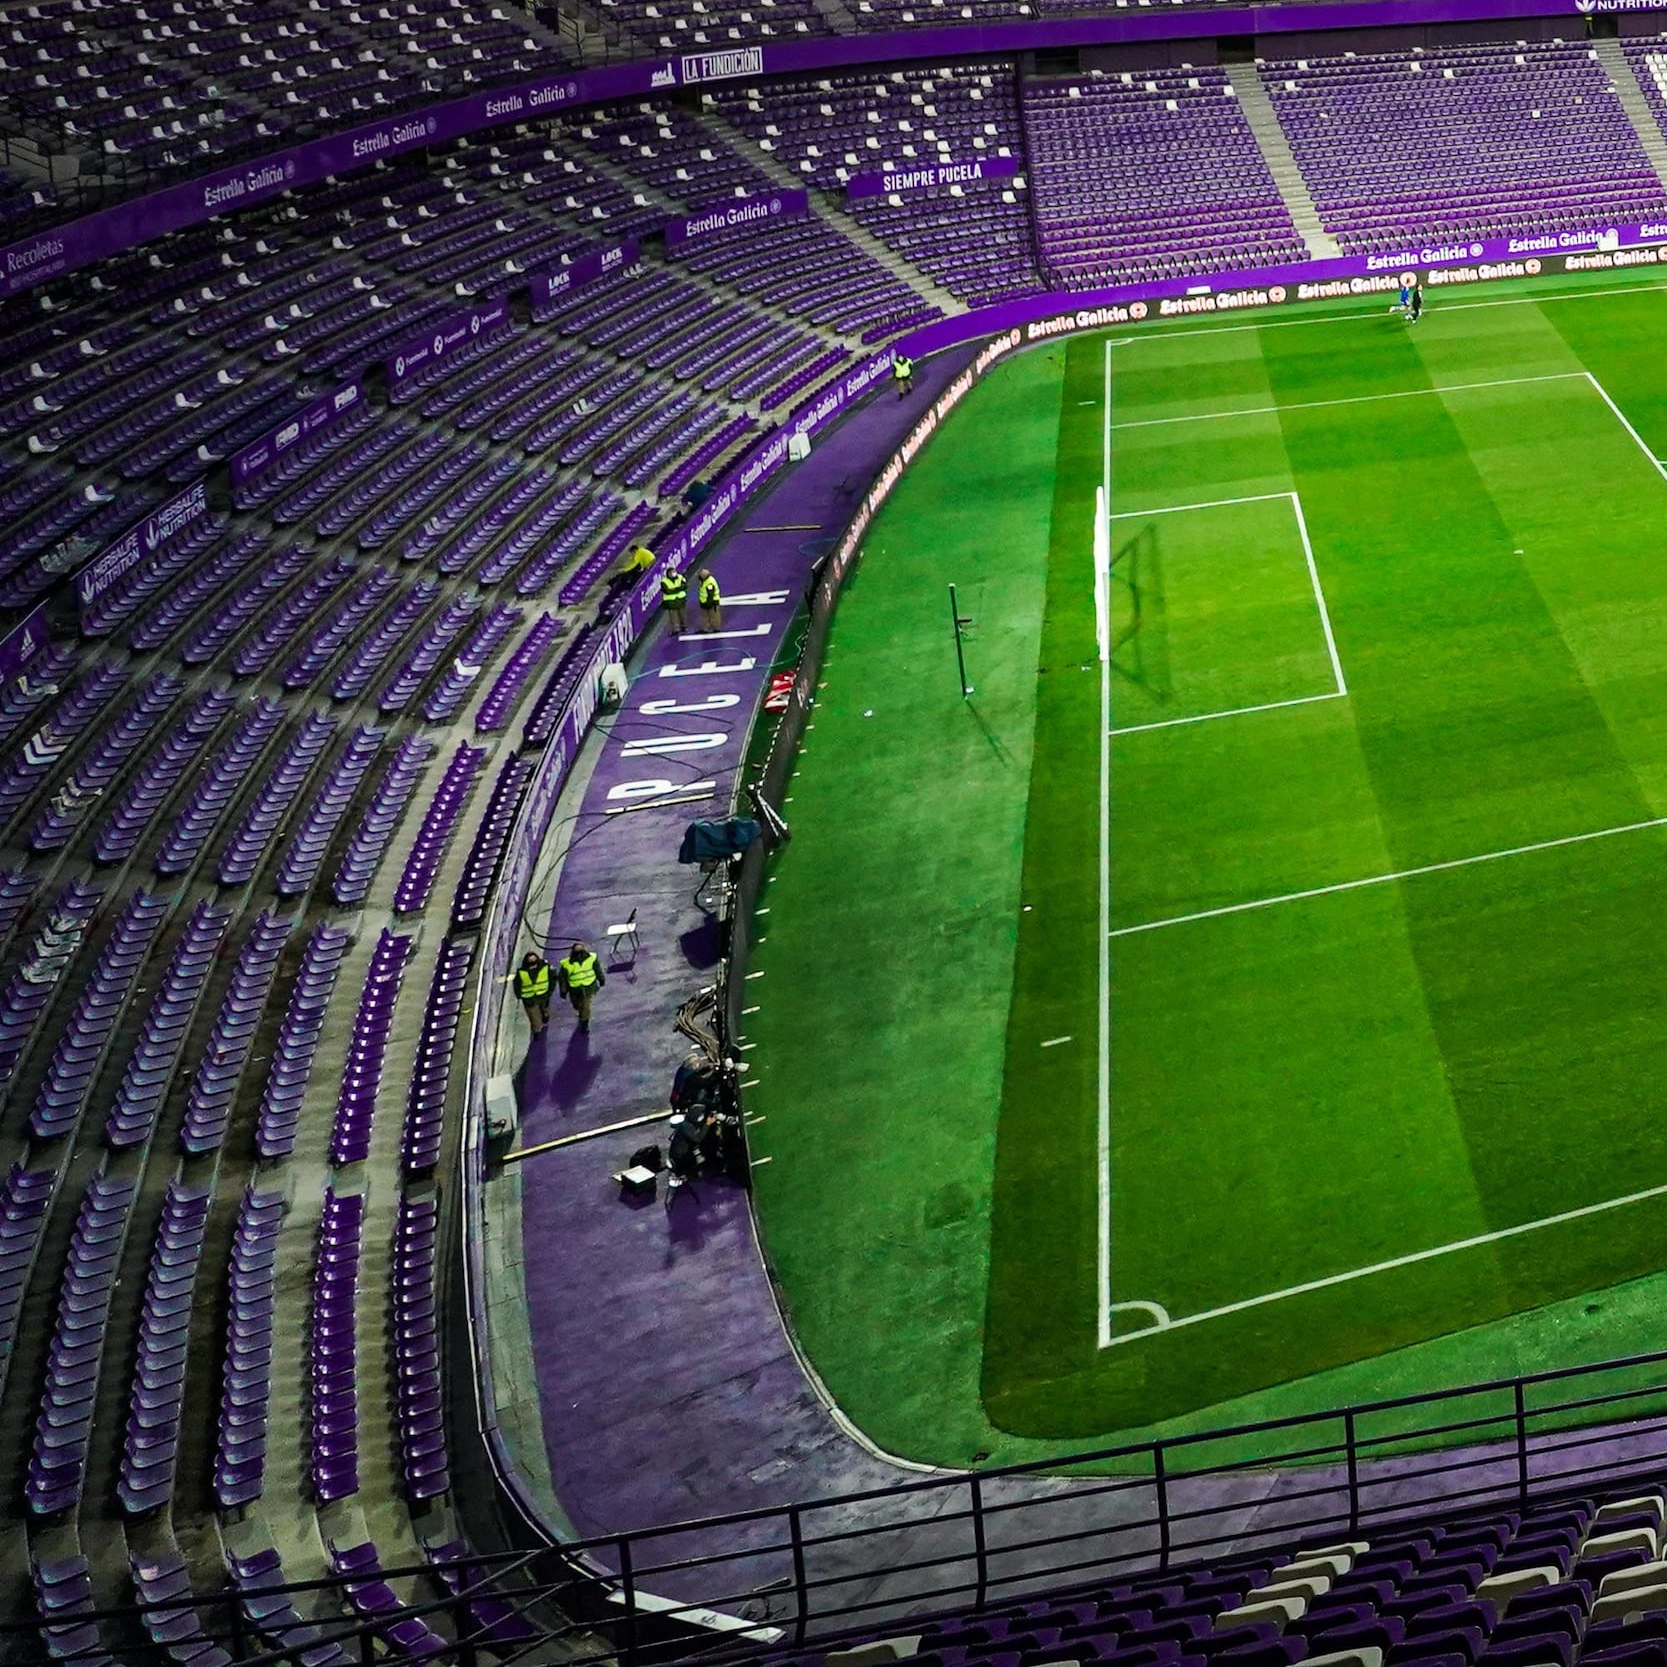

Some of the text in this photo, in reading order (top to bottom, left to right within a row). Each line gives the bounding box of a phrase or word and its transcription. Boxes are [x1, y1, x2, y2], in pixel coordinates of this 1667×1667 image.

[686, 48, 759, 79] LA FUNDICIÓN
[883, 163, 982, 192] SIEMPRE PUCELA
[686, 204, 768, 237] Estrella Galicia
[1508, 230, 1602, 253] Estrella Galicia
[1366, 246, 1468, 270] Estrella Galicia
[1565, 248, 1658, 270] Estrella Galicia
[1428, 261, 1524, 284] Estrella Galicia
[1298, 274, 1400, 300] Estrella Galicia
[1160, 288, 1268, 315] Estrella Galicia
[1028, 306, 1128, 338] Estrella Galicia
